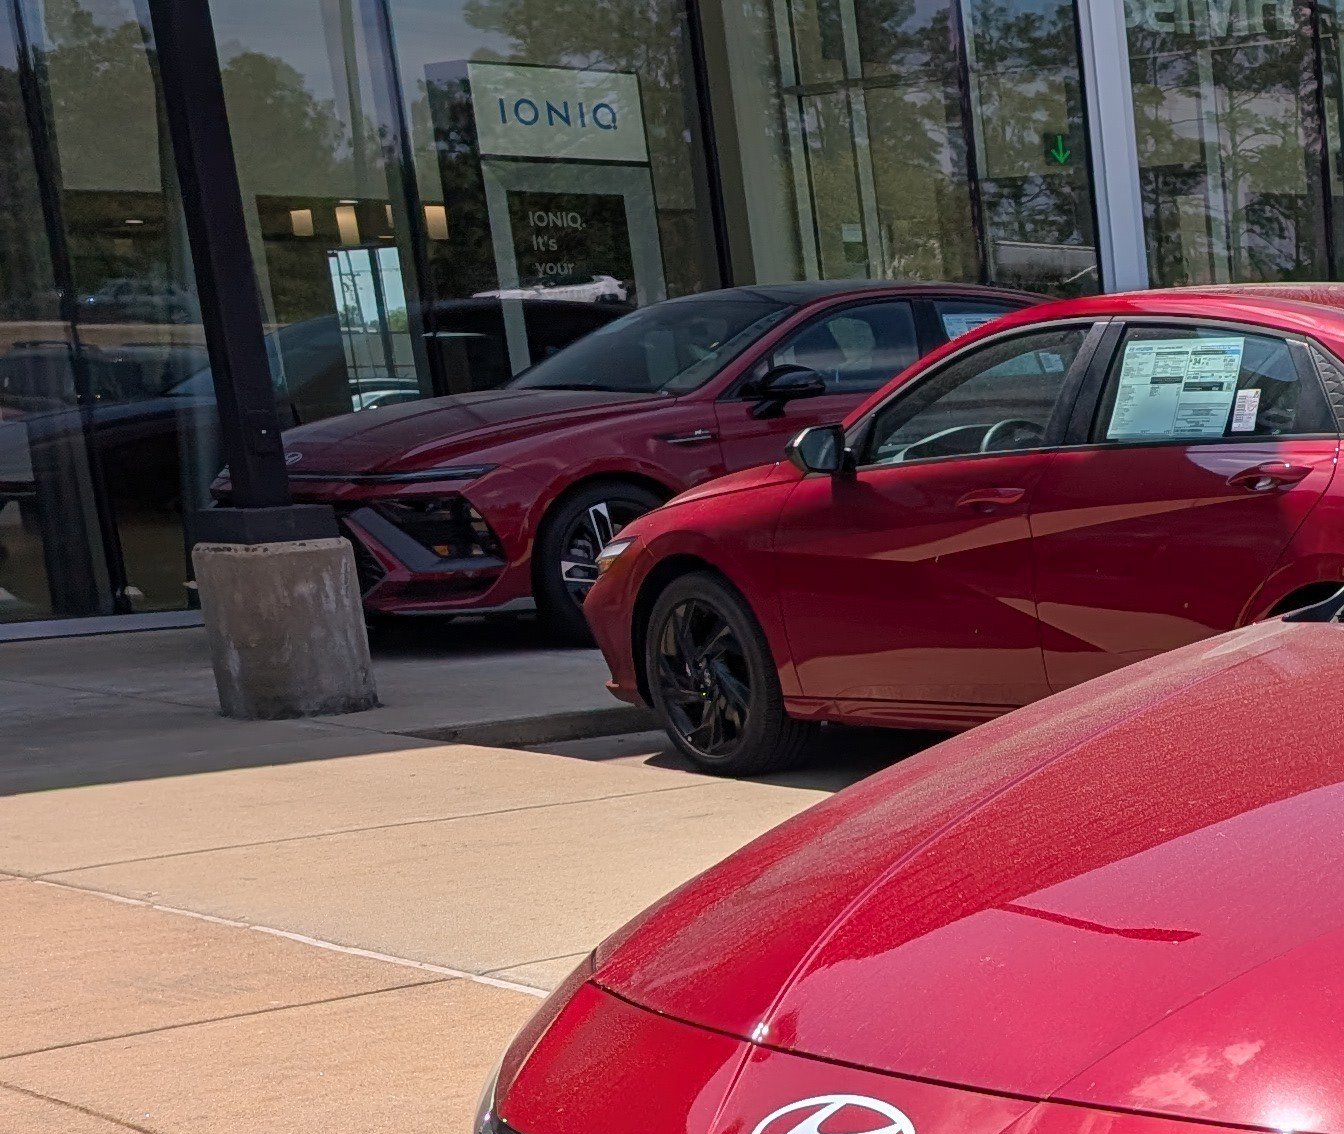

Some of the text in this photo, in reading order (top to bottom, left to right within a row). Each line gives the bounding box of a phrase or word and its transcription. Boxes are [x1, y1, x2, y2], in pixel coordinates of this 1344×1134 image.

[498, 97, 618, 131] IONIQ
[528, 210, 586, 230] IONIQ.
[532, 235, 558, 251] It's
[535, 262, 575, 278] your
